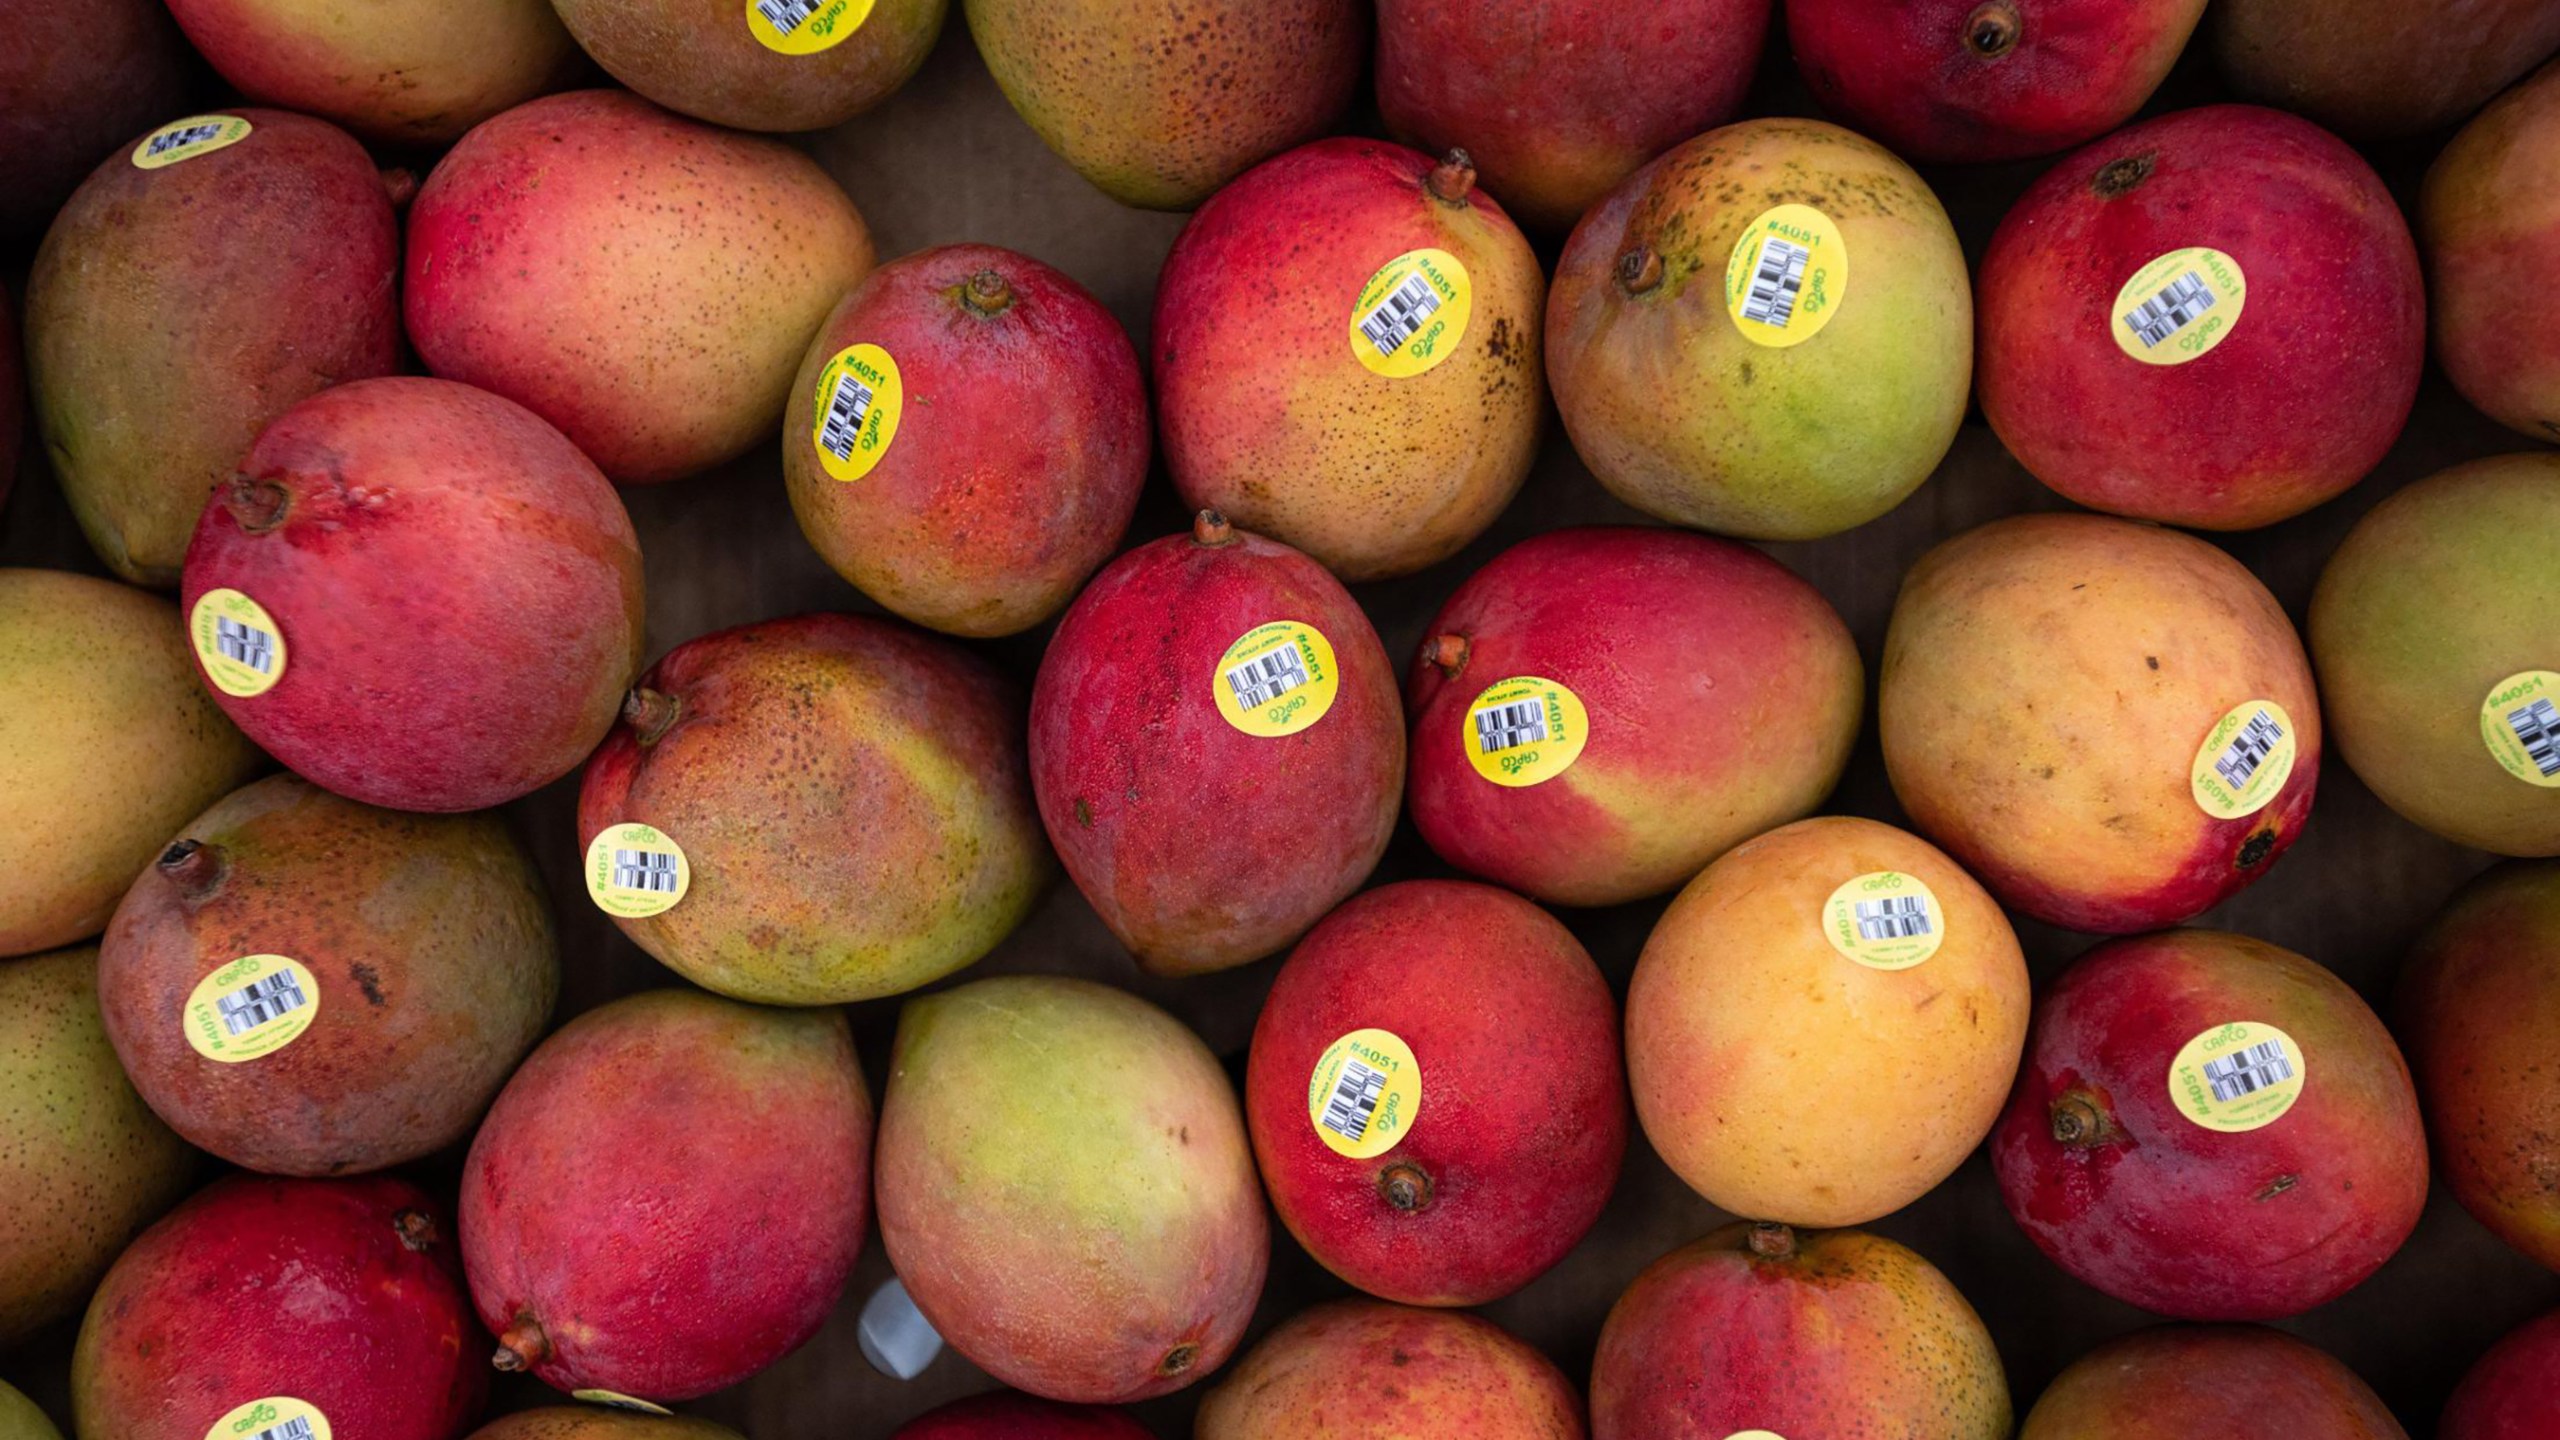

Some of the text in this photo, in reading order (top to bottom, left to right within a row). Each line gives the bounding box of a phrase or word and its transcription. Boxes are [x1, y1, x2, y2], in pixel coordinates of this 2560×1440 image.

[810, 0, 847, 36] CAPCO
[1768, 218, 1820, 246] #4051
[1419, 257, 1457, 300] #4051
[1802, 267, 1826, 314] CAPCO
[2201, 251, 2239, 296] #4051
[1409, 320, 1445, 357] CAPCO
[2178, 314, 2222, 351] CAPCO
[845, 354, 884, 387] #4051
[859, 408, 883, 451] CAPCO
[1295, 633, 1324, 681] #4051
[1267, 695, 1306, 721] CAPCO
[2487, 676, 2543, 708] #4051
[1545, 690, 1564, 744] #4051
[2207, 714, 2238, 751] CAPCO
[1499, 750, 1539, 769] CAPCO
[2198, 772, 2233, 809] #4051
[622, 830, 656, 843] CAPCO
[597, 844, 607, 891] #4051
[1861, 876, 1902, 891] CAPCO
[1834, 899, 1855, 947] #4051
[216, 960, 261, 987] CAPCO
[194, 1003, 224, 1050] #4051
[2203, 1027, 2248, 1052] CAPCO
[1350, 1040, 1398, 1071] #4051
[2179, 1065, 2210, 1115] #4051
[1376, 1091, 1401, 1131] CAPCO
[233, 1406, 277, 1433] CAPCO
